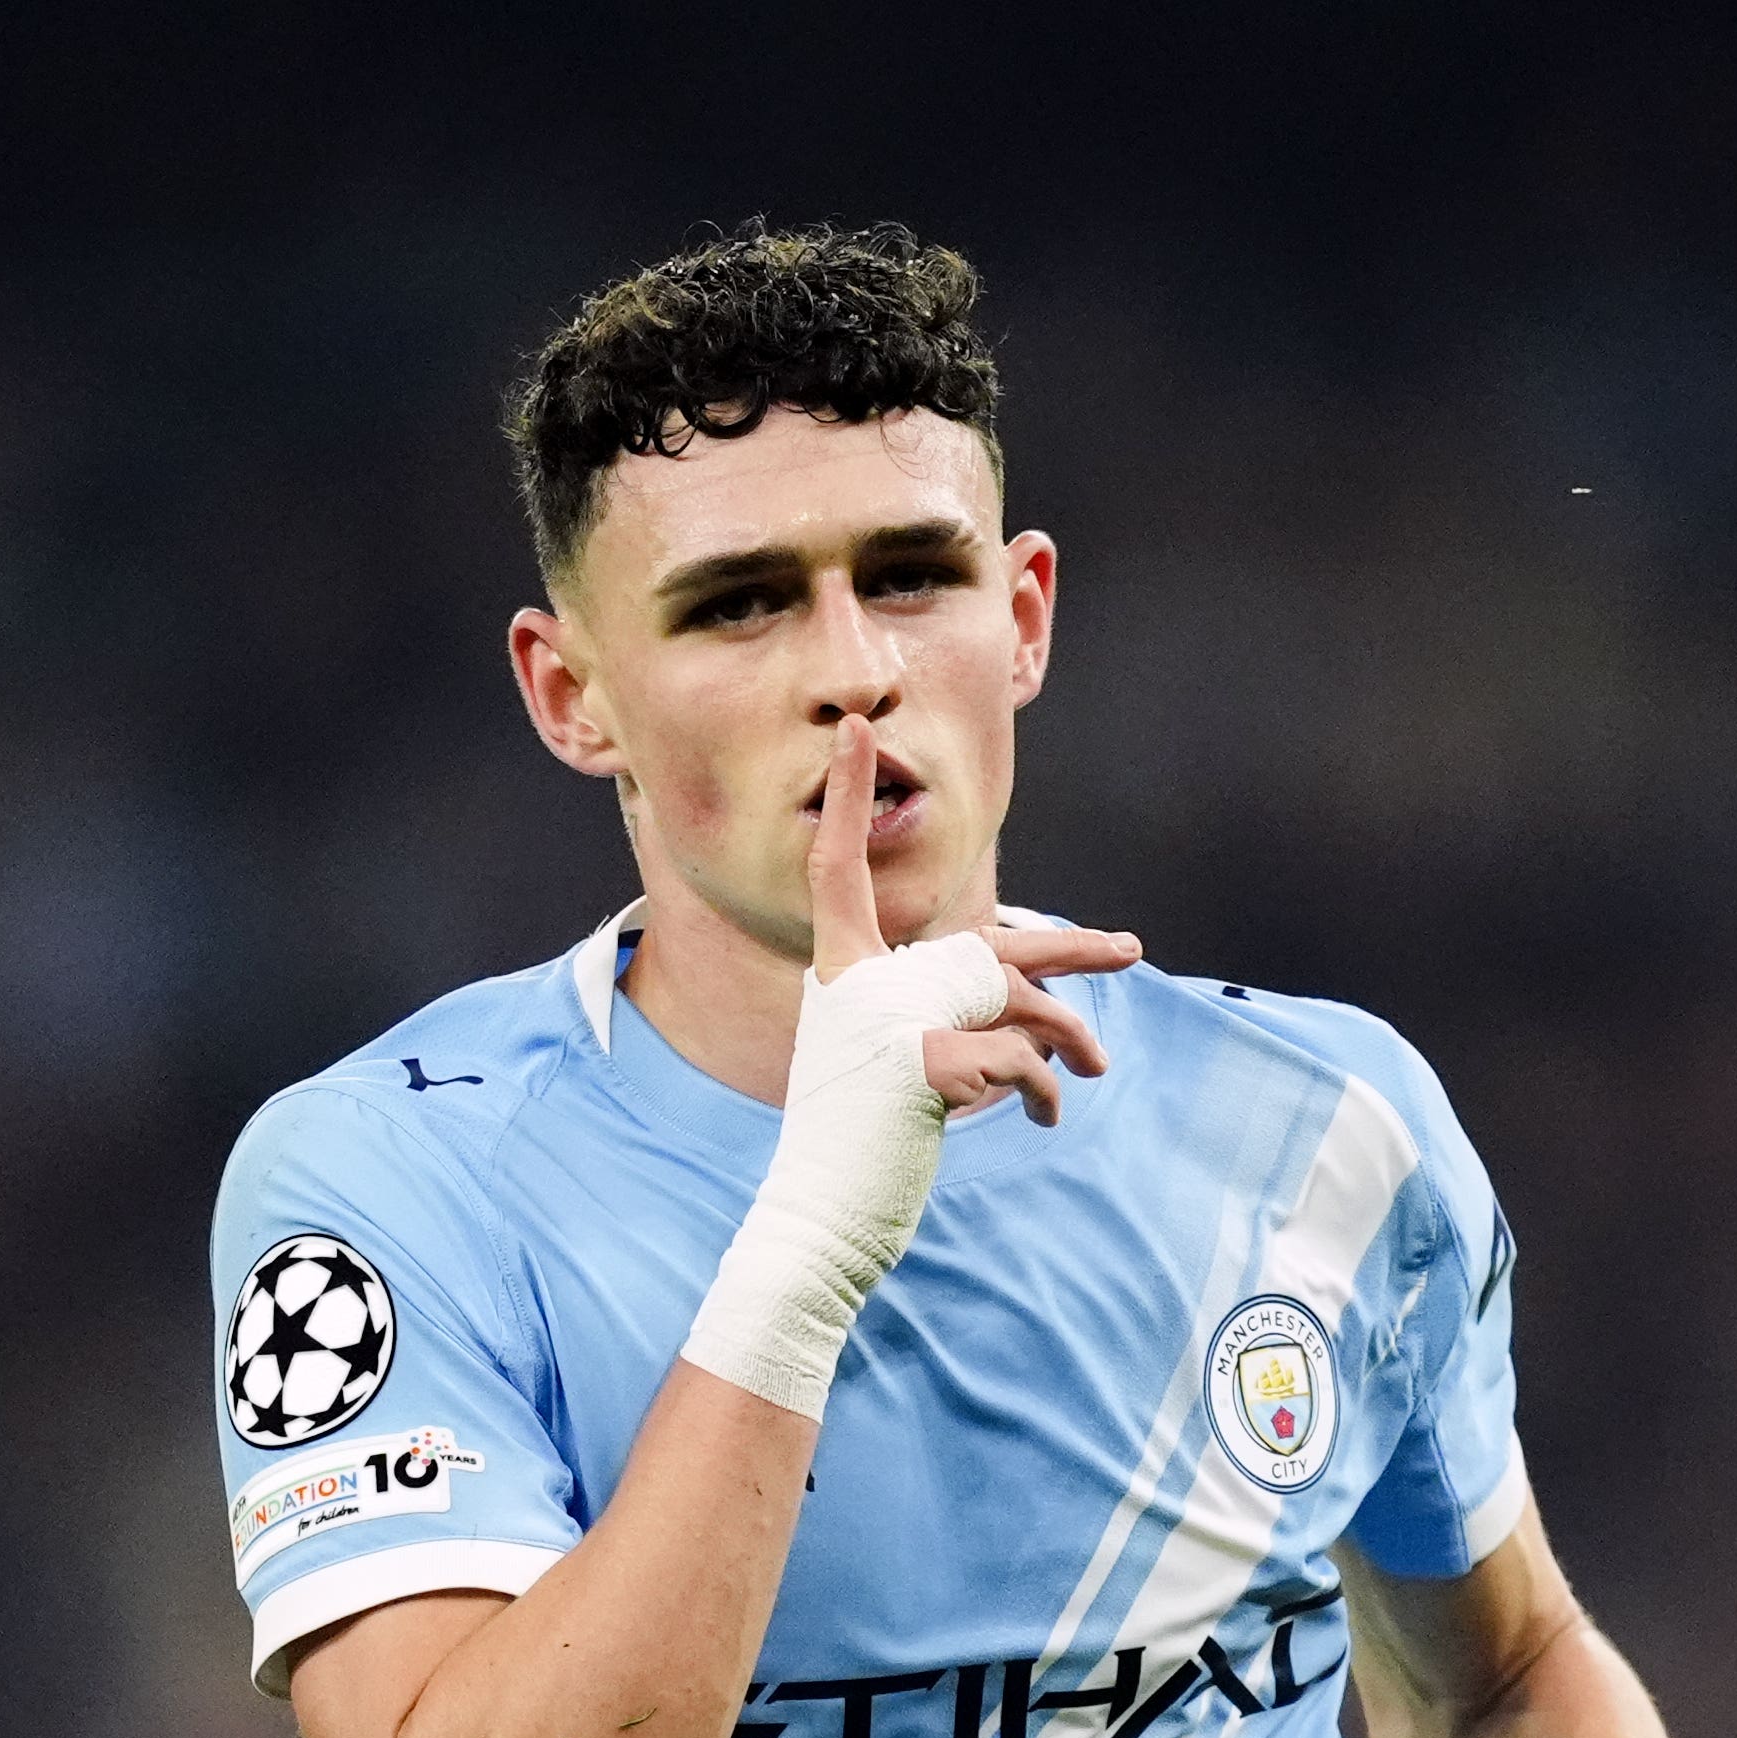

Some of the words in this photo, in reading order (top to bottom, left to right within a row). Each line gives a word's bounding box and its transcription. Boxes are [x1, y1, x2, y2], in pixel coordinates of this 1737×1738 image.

[1218, 1311, 1323, 1376] MANCHESTER
[364, 1452, 439, 1493] 10
[439, 1454, 477, 1465] YEARS
[1271, 1459, 1308, 1479] CITY
